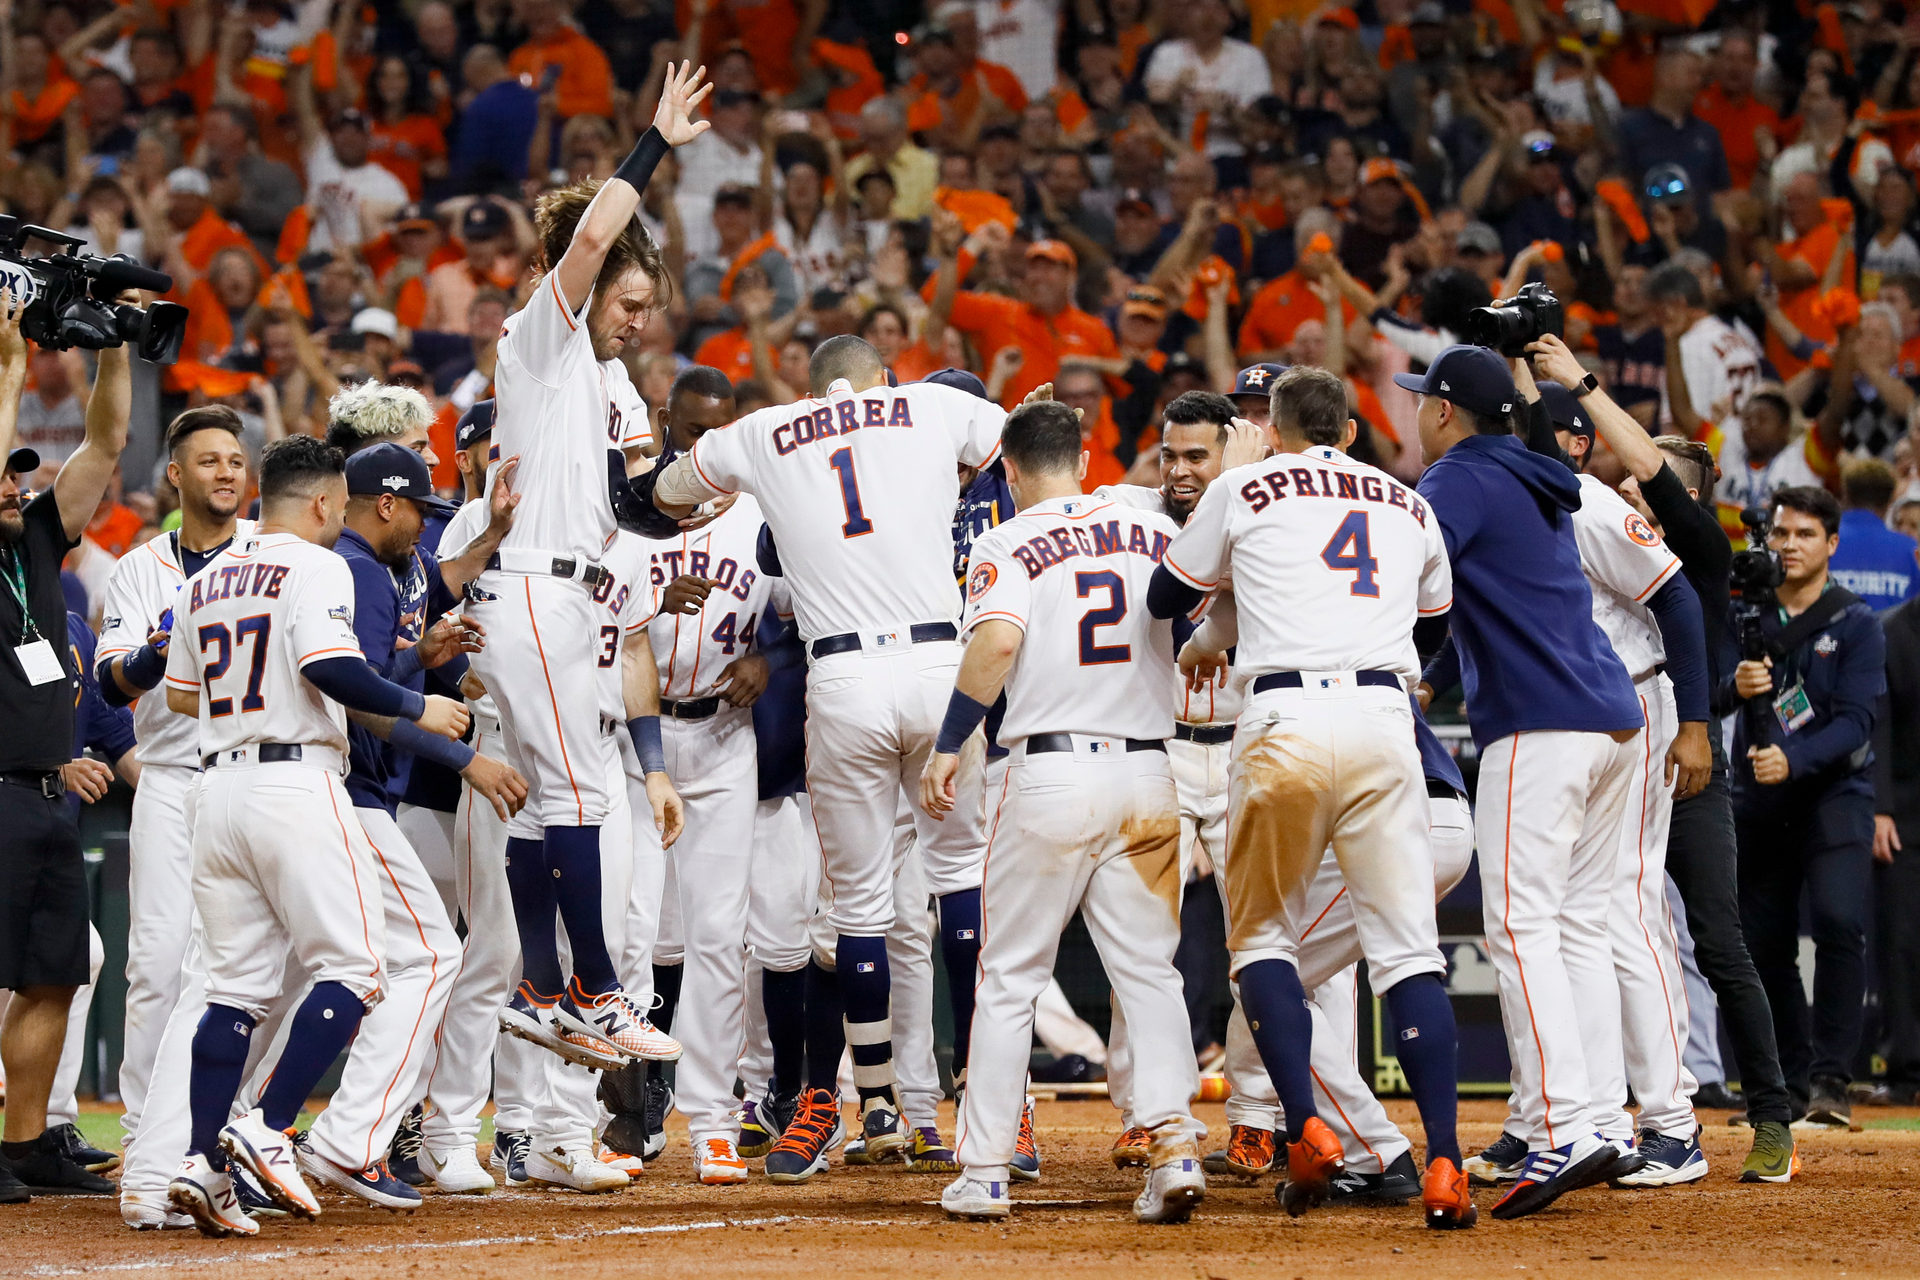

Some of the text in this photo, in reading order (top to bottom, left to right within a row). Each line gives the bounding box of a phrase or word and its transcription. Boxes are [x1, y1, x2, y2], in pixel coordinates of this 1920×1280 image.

[772, 397, 913, 456] CORREA
[829, 445, 874, 539] 1
[1240, 467, 1427, 530] SPRINGER
[650, 549, 756, 601] STROS
[1011, 520, 1173, 581] BREGMAN
[1320, 510, 1380, 599] 4
[190, 563, 290, 616] ALTUVE
[1830, 570, 1911, 598] ECURITY
[598, 625, 619, 669] 3
[711, 612, 757, 655] 44
[1075, 569, 1132, 666] 2
[198, 613, 271, 719] 27
